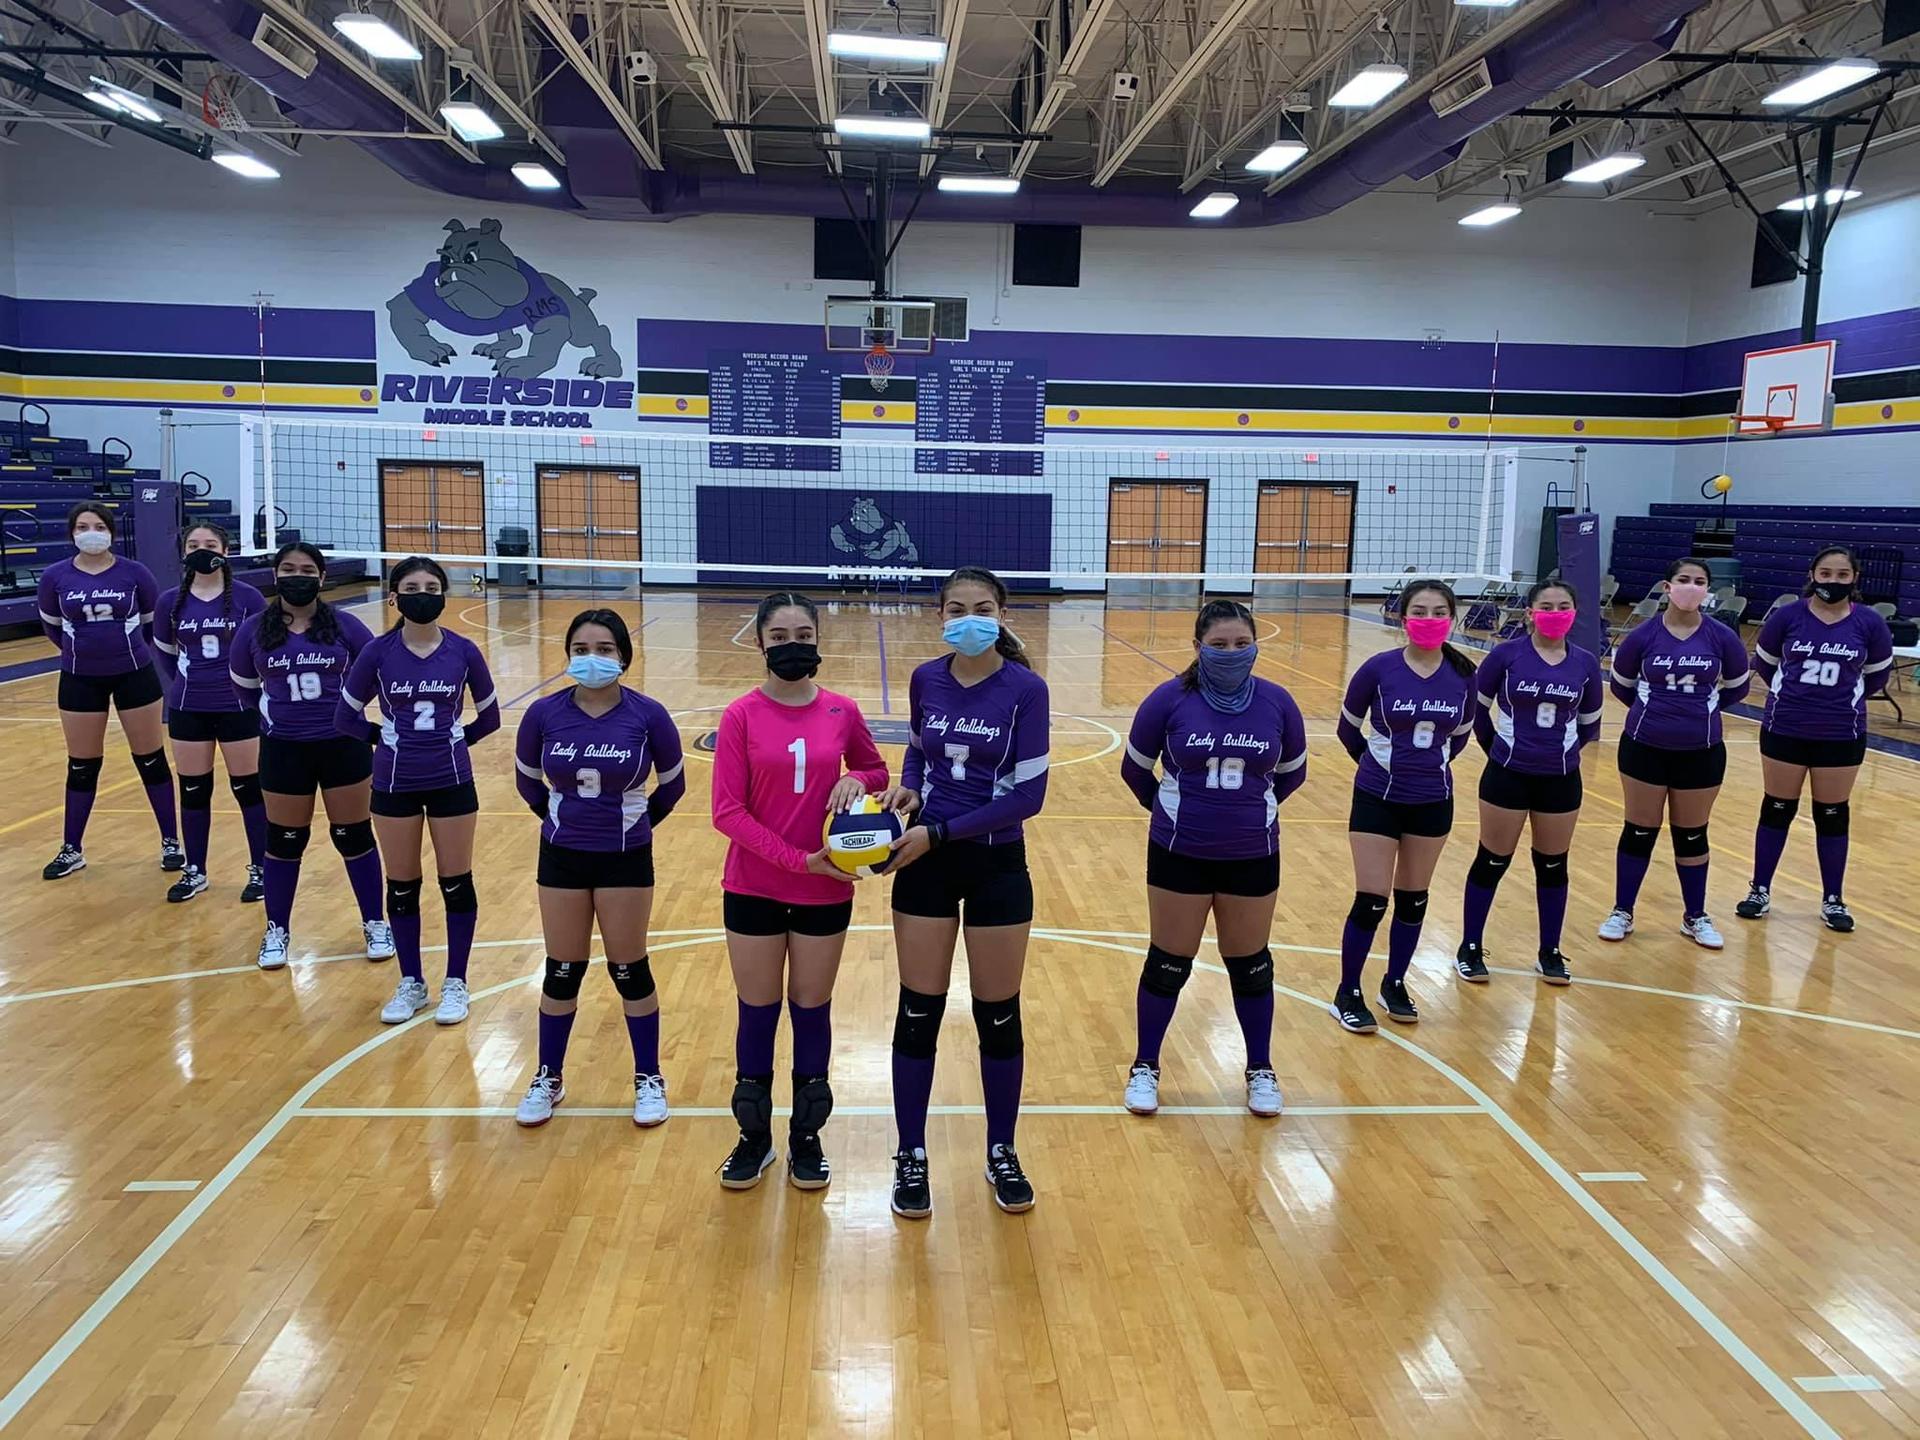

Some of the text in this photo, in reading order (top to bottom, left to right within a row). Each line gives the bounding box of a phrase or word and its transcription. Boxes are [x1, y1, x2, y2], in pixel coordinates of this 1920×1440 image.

[522, 296, 562, 321] RMS
[381, 374, 635, 409] RIVERSIDE
[423, 408, 593, 428] MIDDLE SCHOOL
[66, 589, 125, 602] Lady Bulldogs
[83, 604, 113, 622] 12
[179, 619, 198, 632] Lady
[201, 635, 219, 658] 9
[1791, 641, 1858, 659] Lady Bulldogs
[268, 653, 335, 670] Lady Bulldogs
[1653, 656, 1712, 670] Lady Bulldogs
[1666, 674, 1697, 693] 14
[1800, 660, 1840, 686] 20
[287, 672, 321, 701] 19
[390, 680, 455, 697] Lady Bulldogs
[1517, 681, 1578, 702] Lady Bulldogs
[414, 701, 435, 730] 2
[1392, 699, 1458, 717] Lady Bulldogs
[926, 715, 1000, 742] Lady Bulldogs
[550, 742, 631, 763] Lady Bulldogs
[1186, 732, 1269, 754] Lady Bulldogs
[788, 738, 806, 793] 1
[945, 743, 969, 780] 7
[577, 768, 600, 798] 3
[841, 836, 875, 846] TACHIKARA
